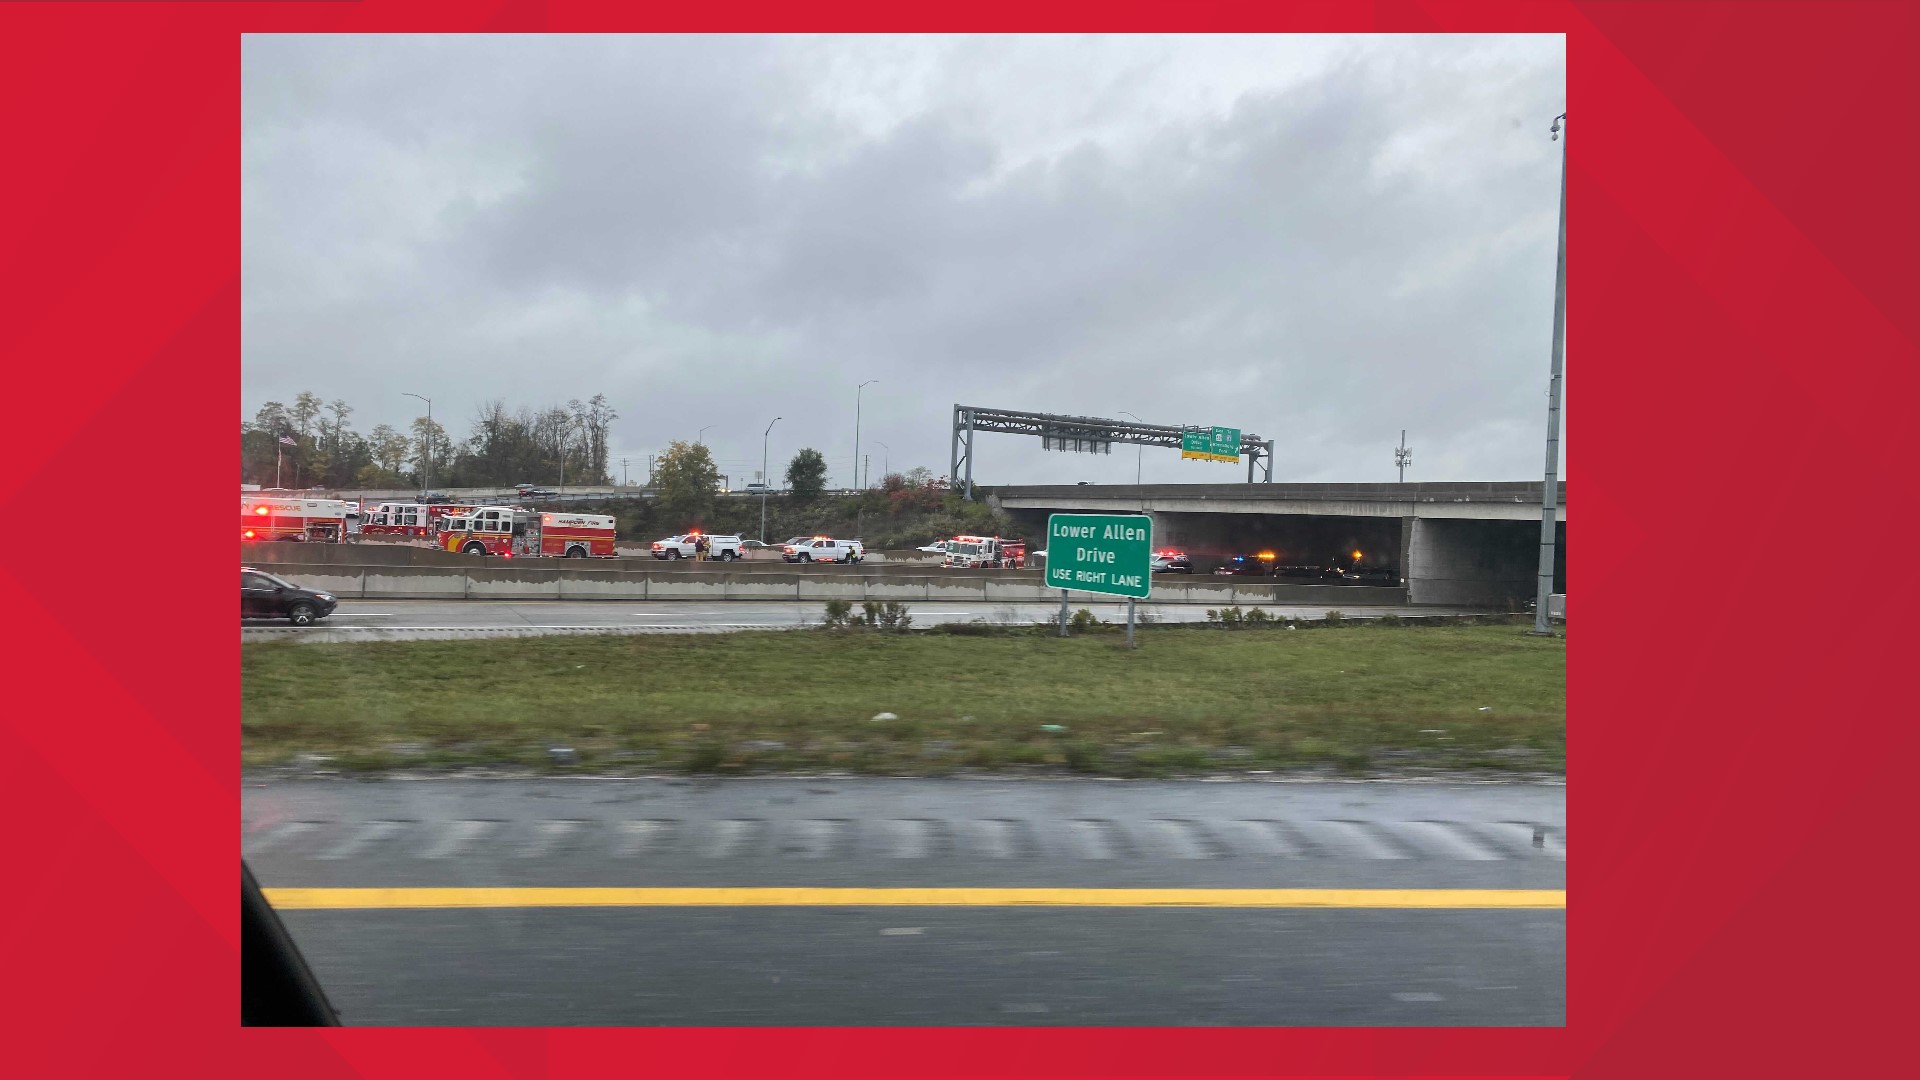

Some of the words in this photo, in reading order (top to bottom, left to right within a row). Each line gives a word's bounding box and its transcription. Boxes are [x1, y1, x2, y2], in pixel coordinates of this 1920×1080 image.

[1053, 523, 1096, 539] Lower
[1103, 524, 1145, 540] Allen
[1076, 547, 1116, 563] Drive
[1052, 568, 1072, 580] USE
[1076, 571, 1106, 583] RIGHT
[1111, 573, 1142, 588] LANE
